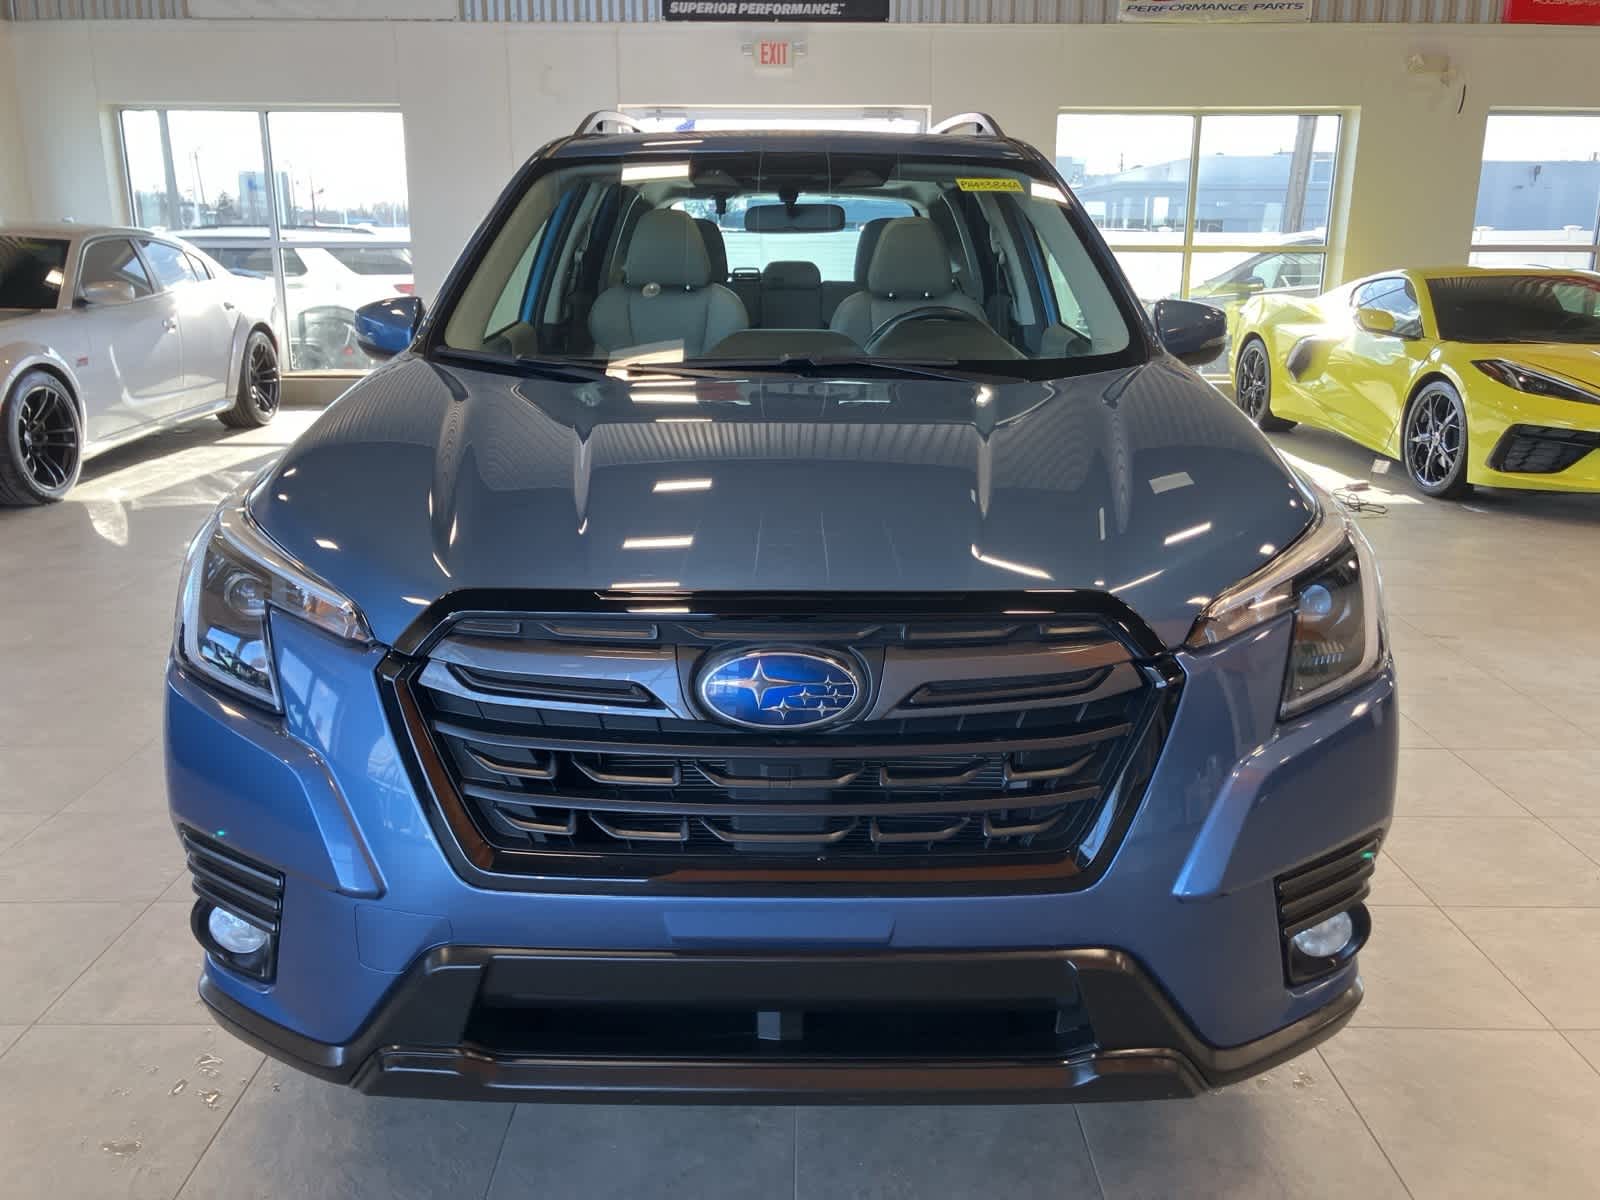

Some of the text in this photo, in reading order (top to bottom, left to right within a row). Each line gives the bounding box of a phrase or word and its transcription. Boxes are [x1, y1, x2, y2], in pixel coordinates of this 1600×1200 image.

[669, 2, 736, 15] SUPERIOR
[1126, 2, 1304, 13] PERFORMANCE PARTS
[760, 43, 788, 65] EXIT
